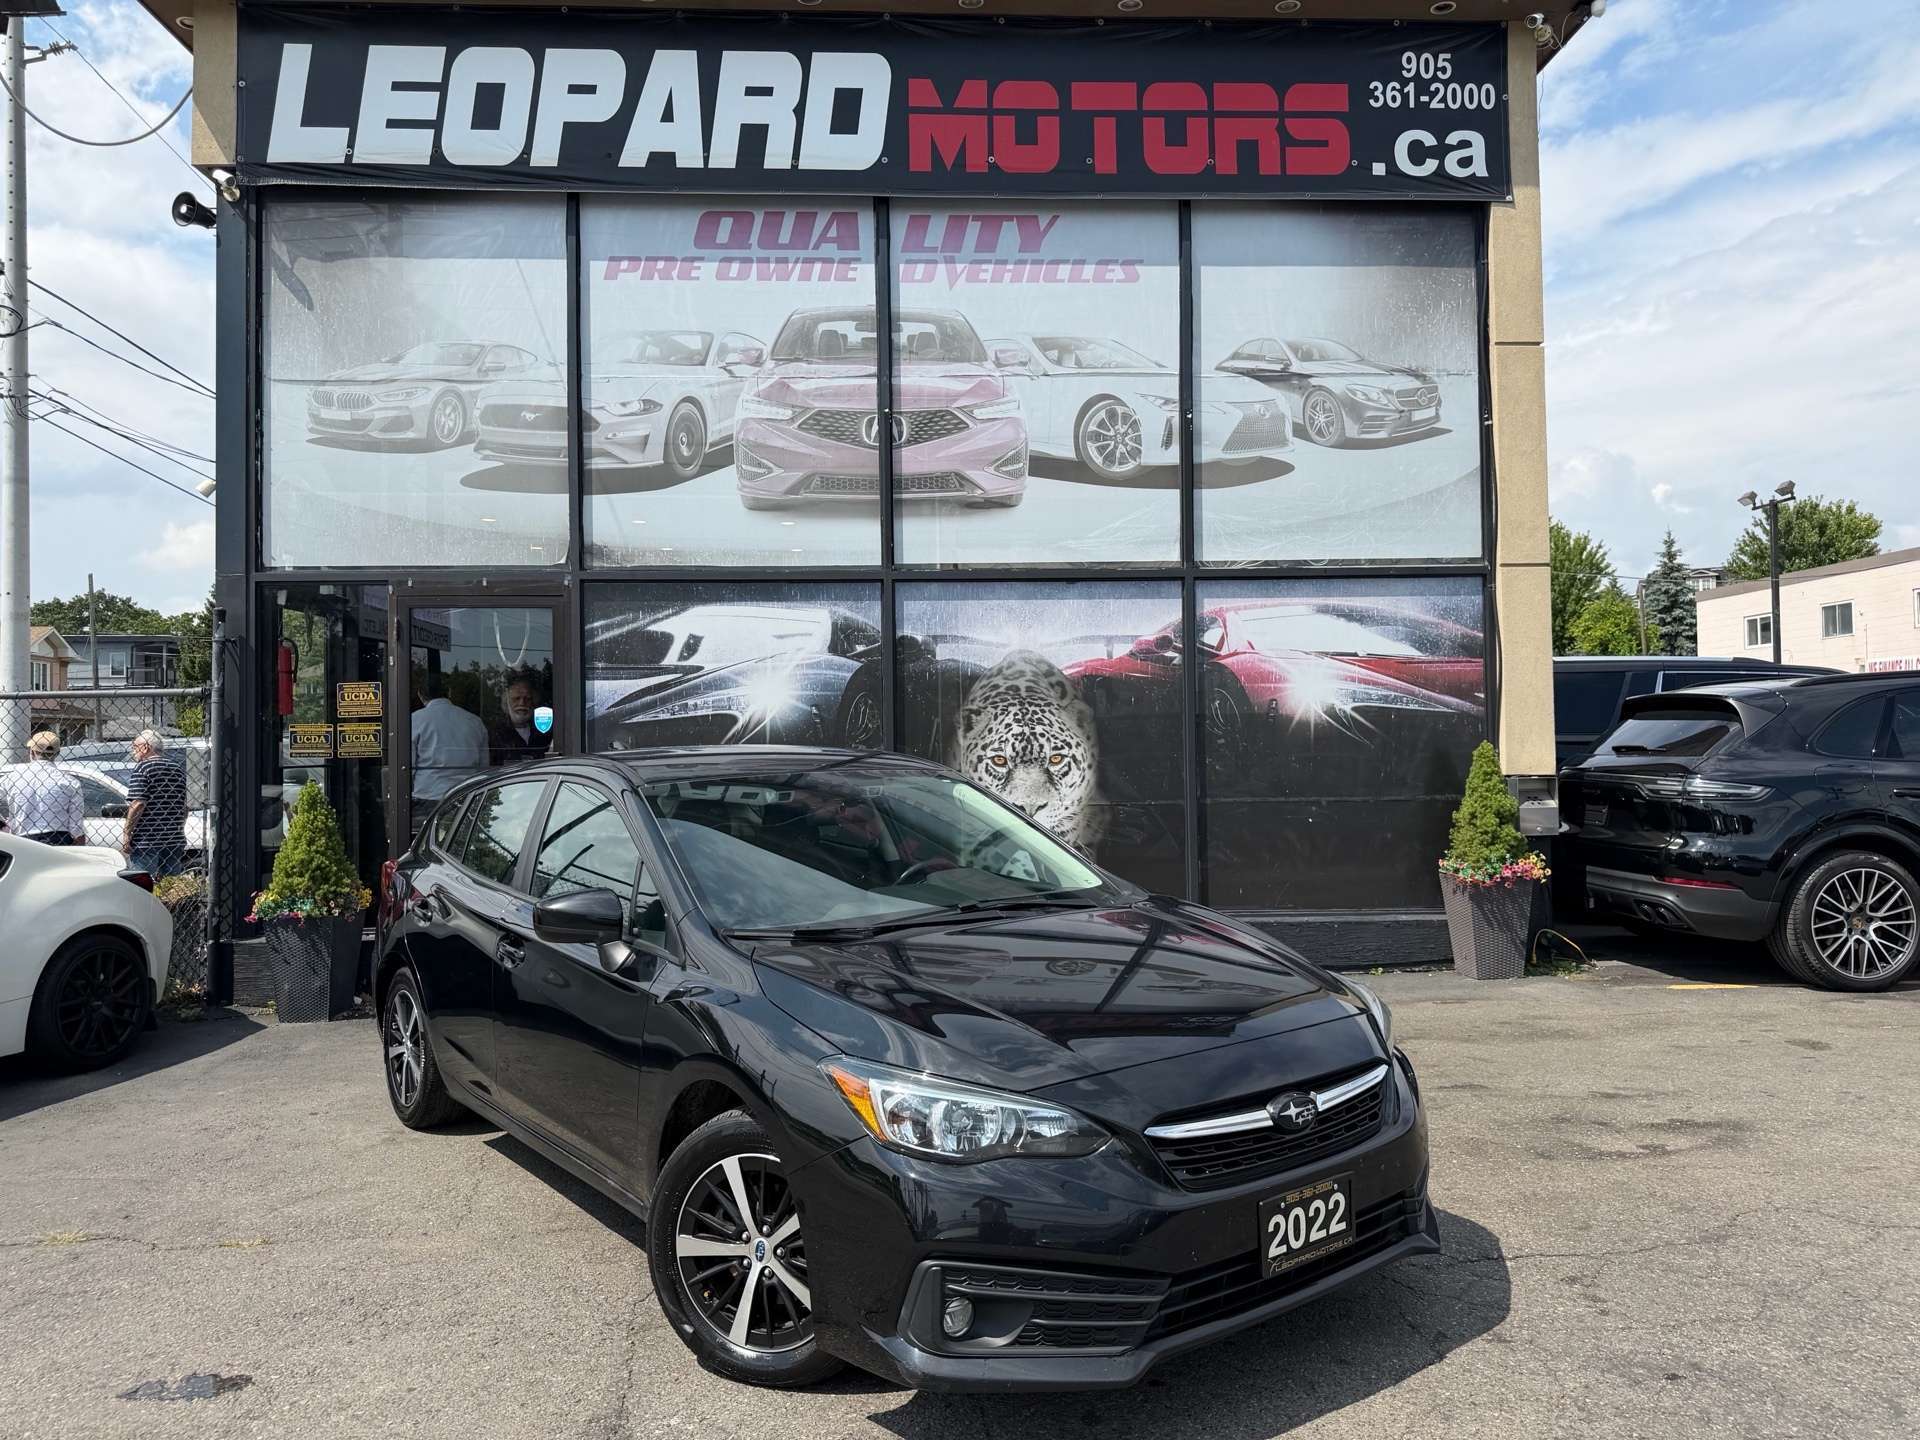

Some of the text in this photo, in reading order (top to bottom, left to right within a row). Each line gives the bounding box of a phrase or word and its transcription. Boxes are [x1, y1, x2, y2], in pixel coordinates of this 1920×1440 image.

[1402, 51, 1452, 79] 905
[267, 43, 1351, 176] LEOPARD MOTORS
[1369, 81, 1496, 110] 361-2000
[1372, 129, 1489, 178] .ca
[603, 255, 705, 281] PRE
[344, 691, 375, 701] UCDA
[296, 735, 326, 743] UCDA
[345, 734, 375, 743] UCDA
[1268, 1192, 1347, 1258] 2022
